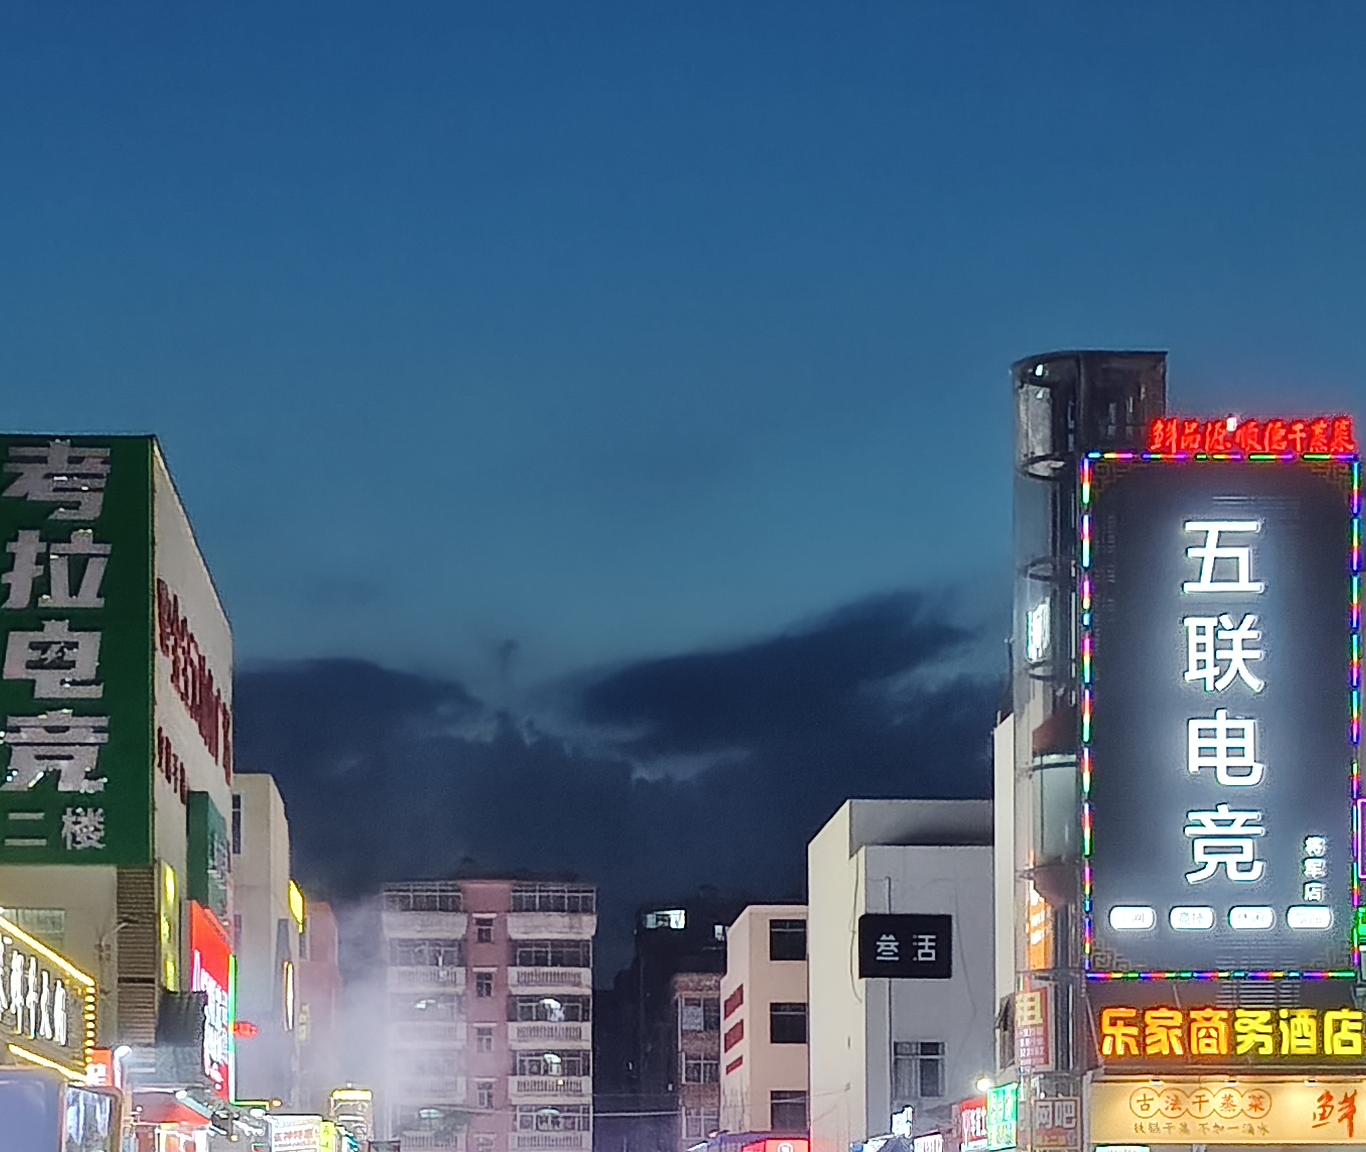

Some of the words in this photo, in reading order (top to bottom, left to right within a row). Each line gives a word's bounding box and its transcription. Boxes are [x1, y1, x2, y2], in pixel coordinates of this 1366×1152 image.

[1182, 517, 1267, 885] 五联电竞
[3, 806, 106, 850] 二楼
[1303, 834, 1327, 901] 将军店
[1099, 1007, 1366, 1057] 乐家商务酒店
[1035, 1100, 1078, 1130] 网吧
[1135, 1093, 1268, 1114] 古法干蒸菜
